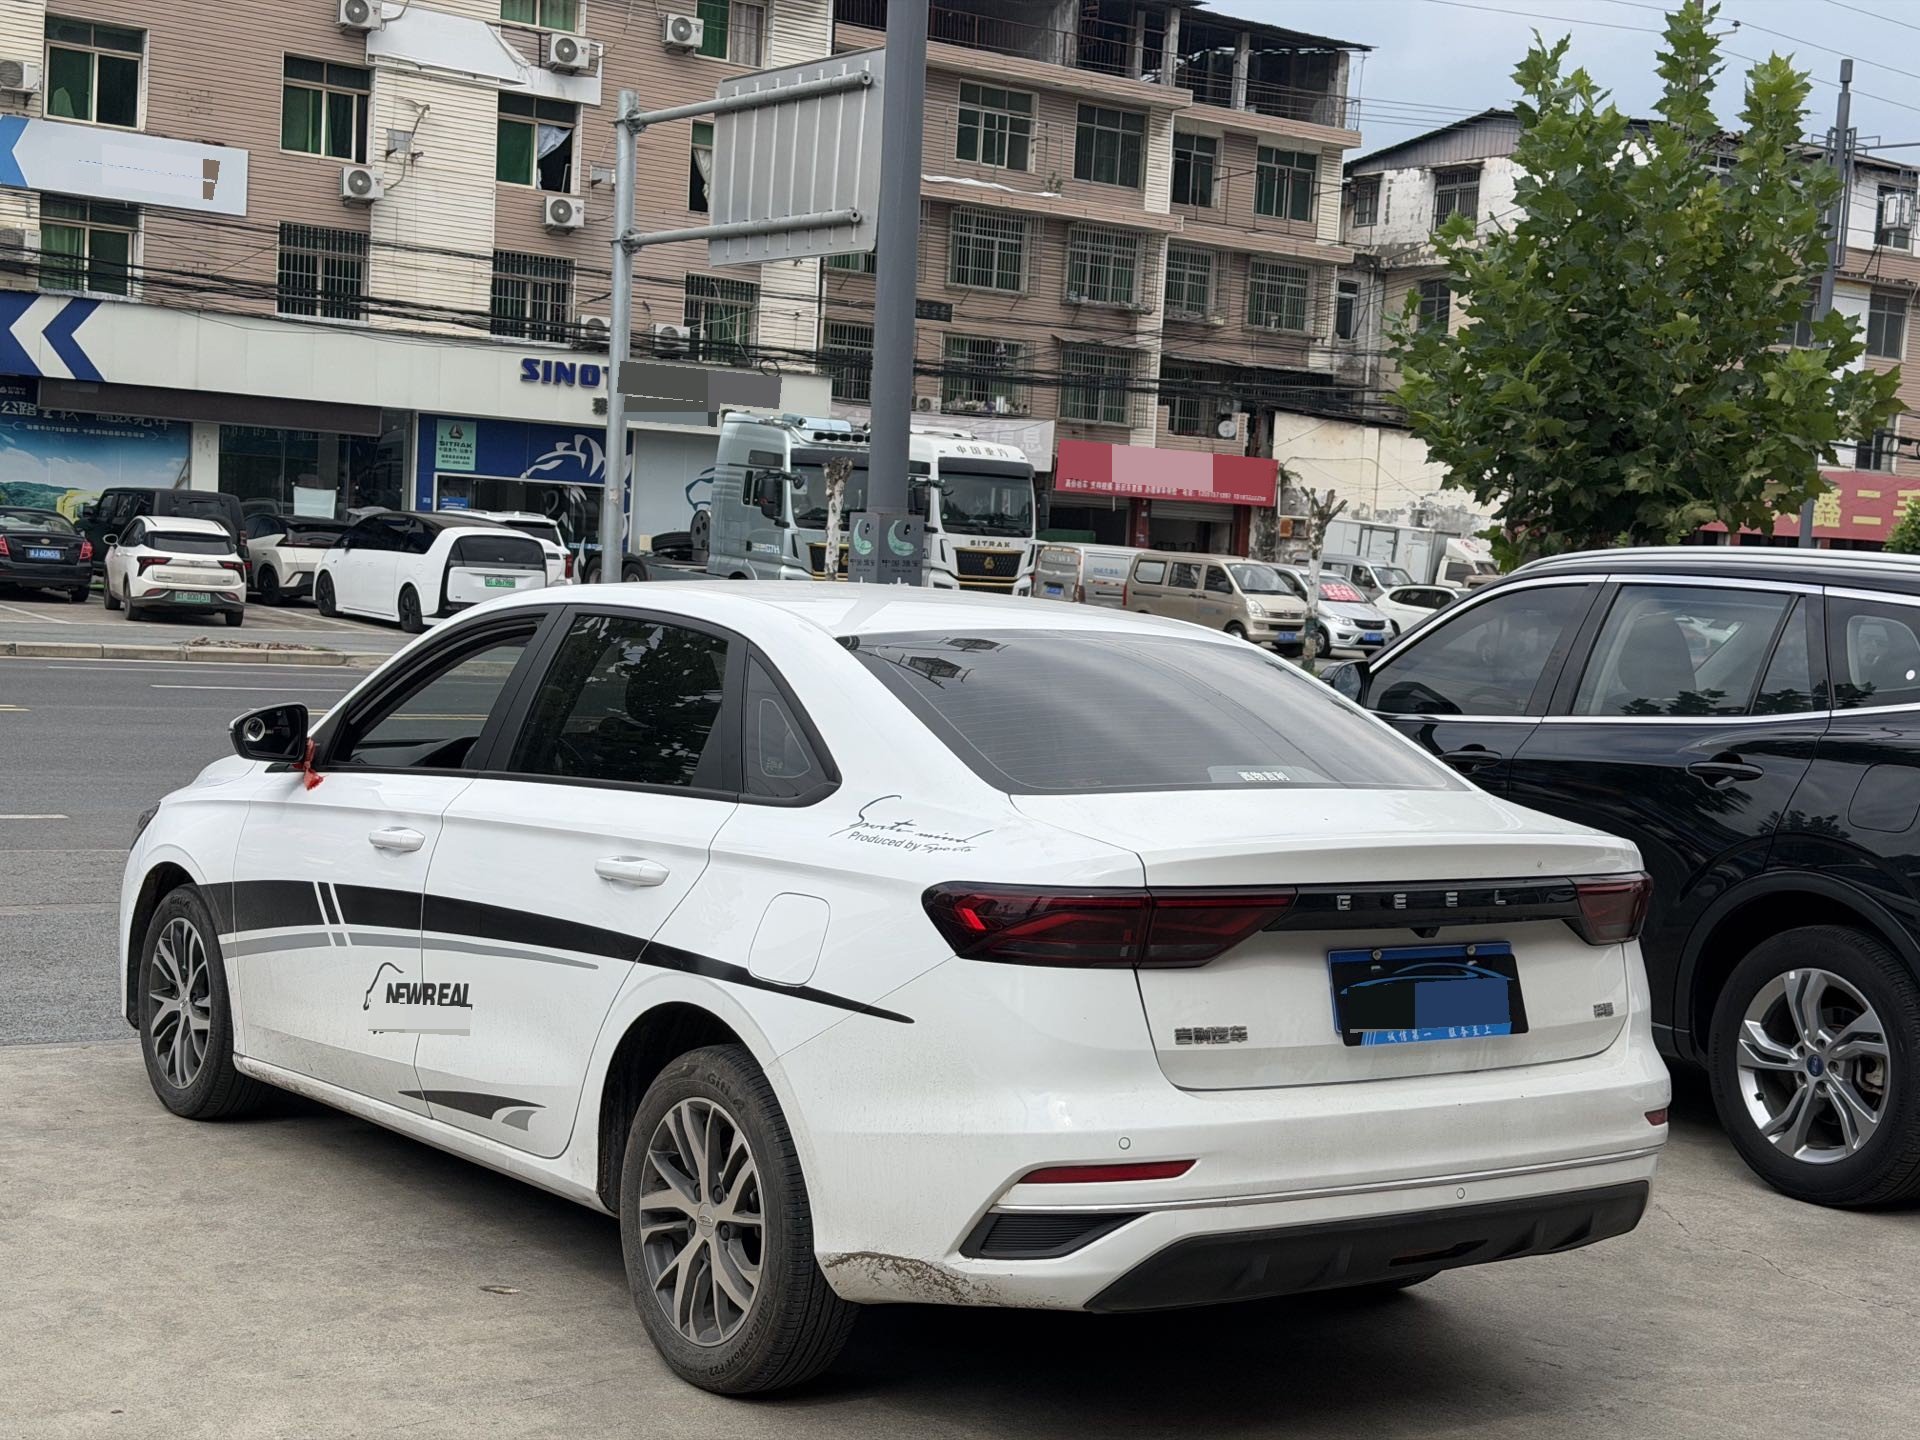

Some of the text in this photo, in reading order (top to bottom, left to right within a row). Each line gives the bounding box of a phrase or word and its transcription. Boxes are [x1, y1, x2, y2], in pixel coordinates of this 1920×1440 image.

[956, 445, 1009, 458] 中国重汽
[970, 539, 1010, 547] SITRAK
[848, 831, 904, 848] Produced
[903, 840, 921, 852] by
[385, 982, 473, 1008] NEWREAL
